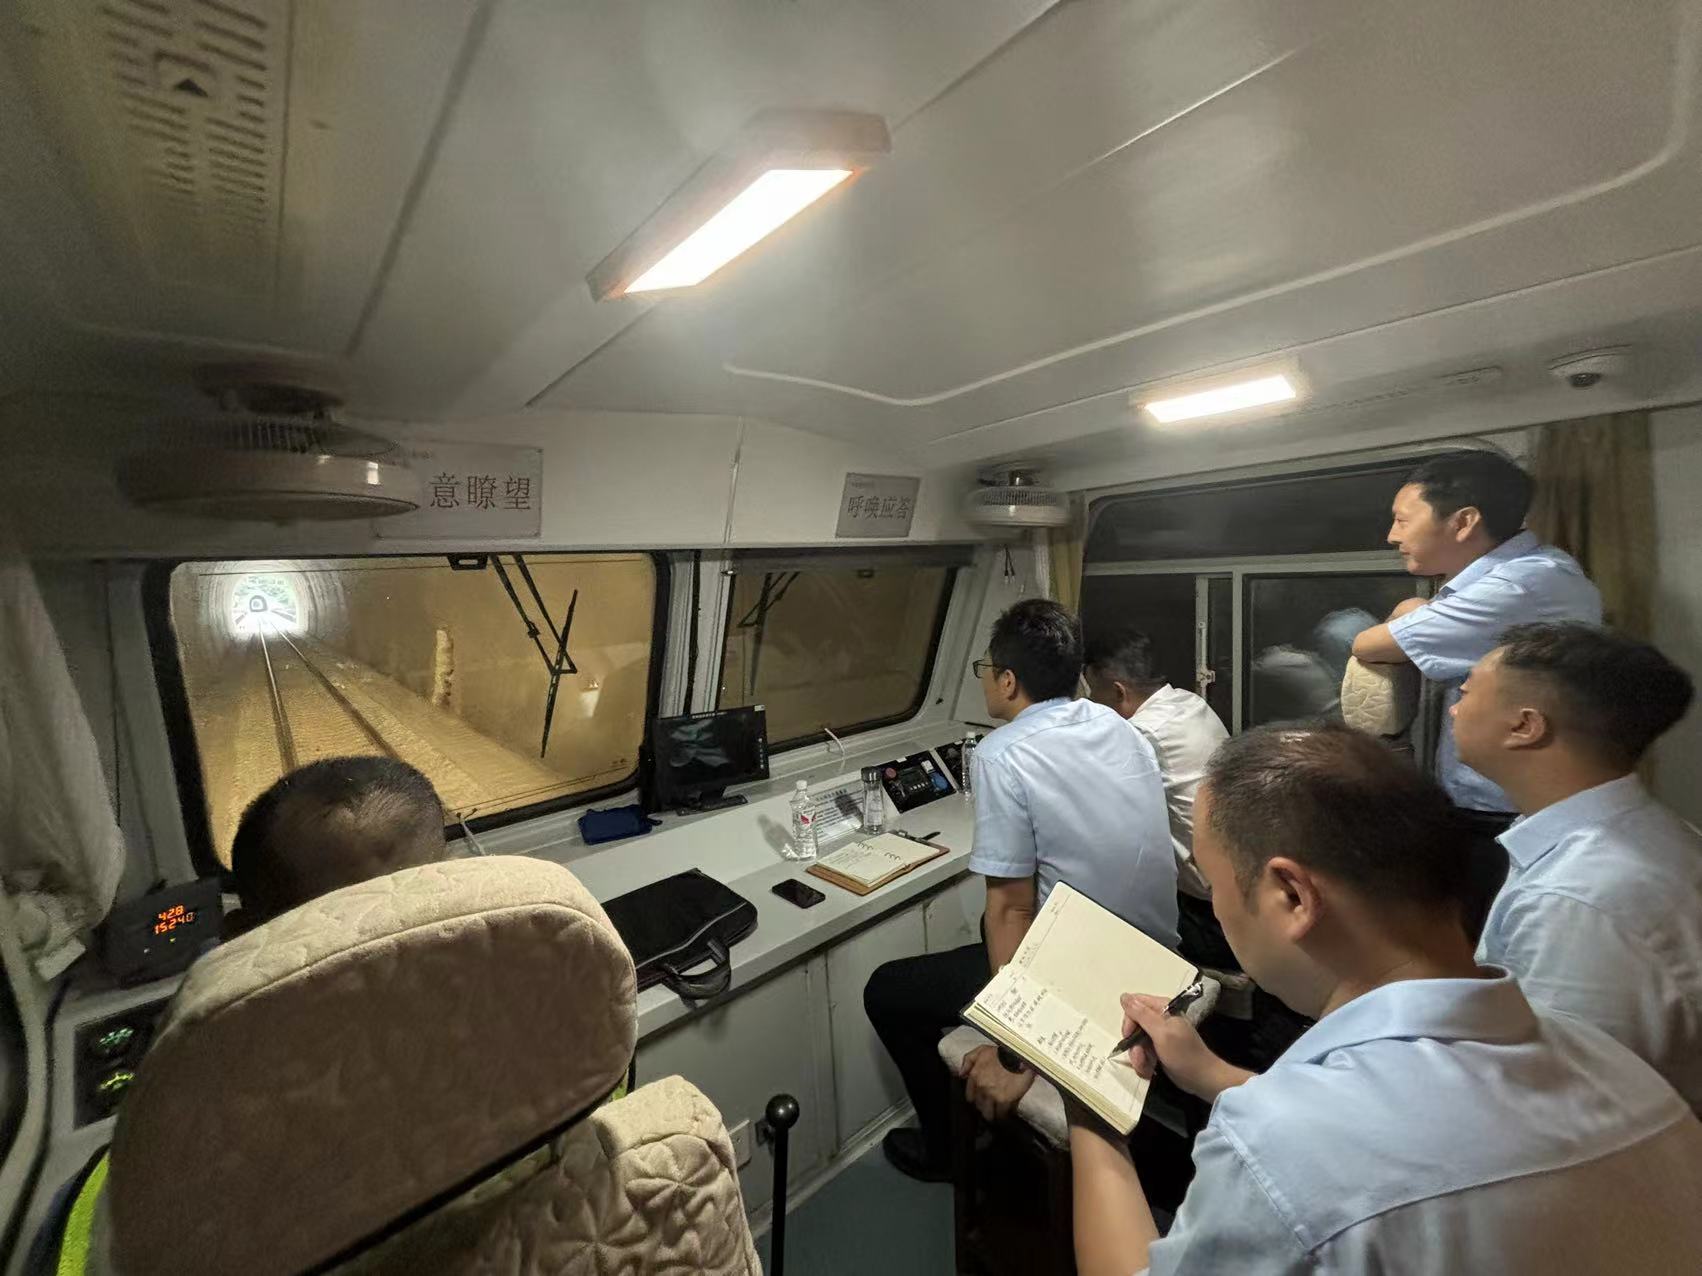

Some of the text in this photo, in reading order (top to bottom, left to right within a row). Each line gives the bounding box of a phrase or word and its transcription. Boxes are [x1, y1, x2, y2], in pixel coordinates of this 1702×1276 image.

[429, 471, 531, 510] 意瞭望
[158, 904, 184, 921] 428
